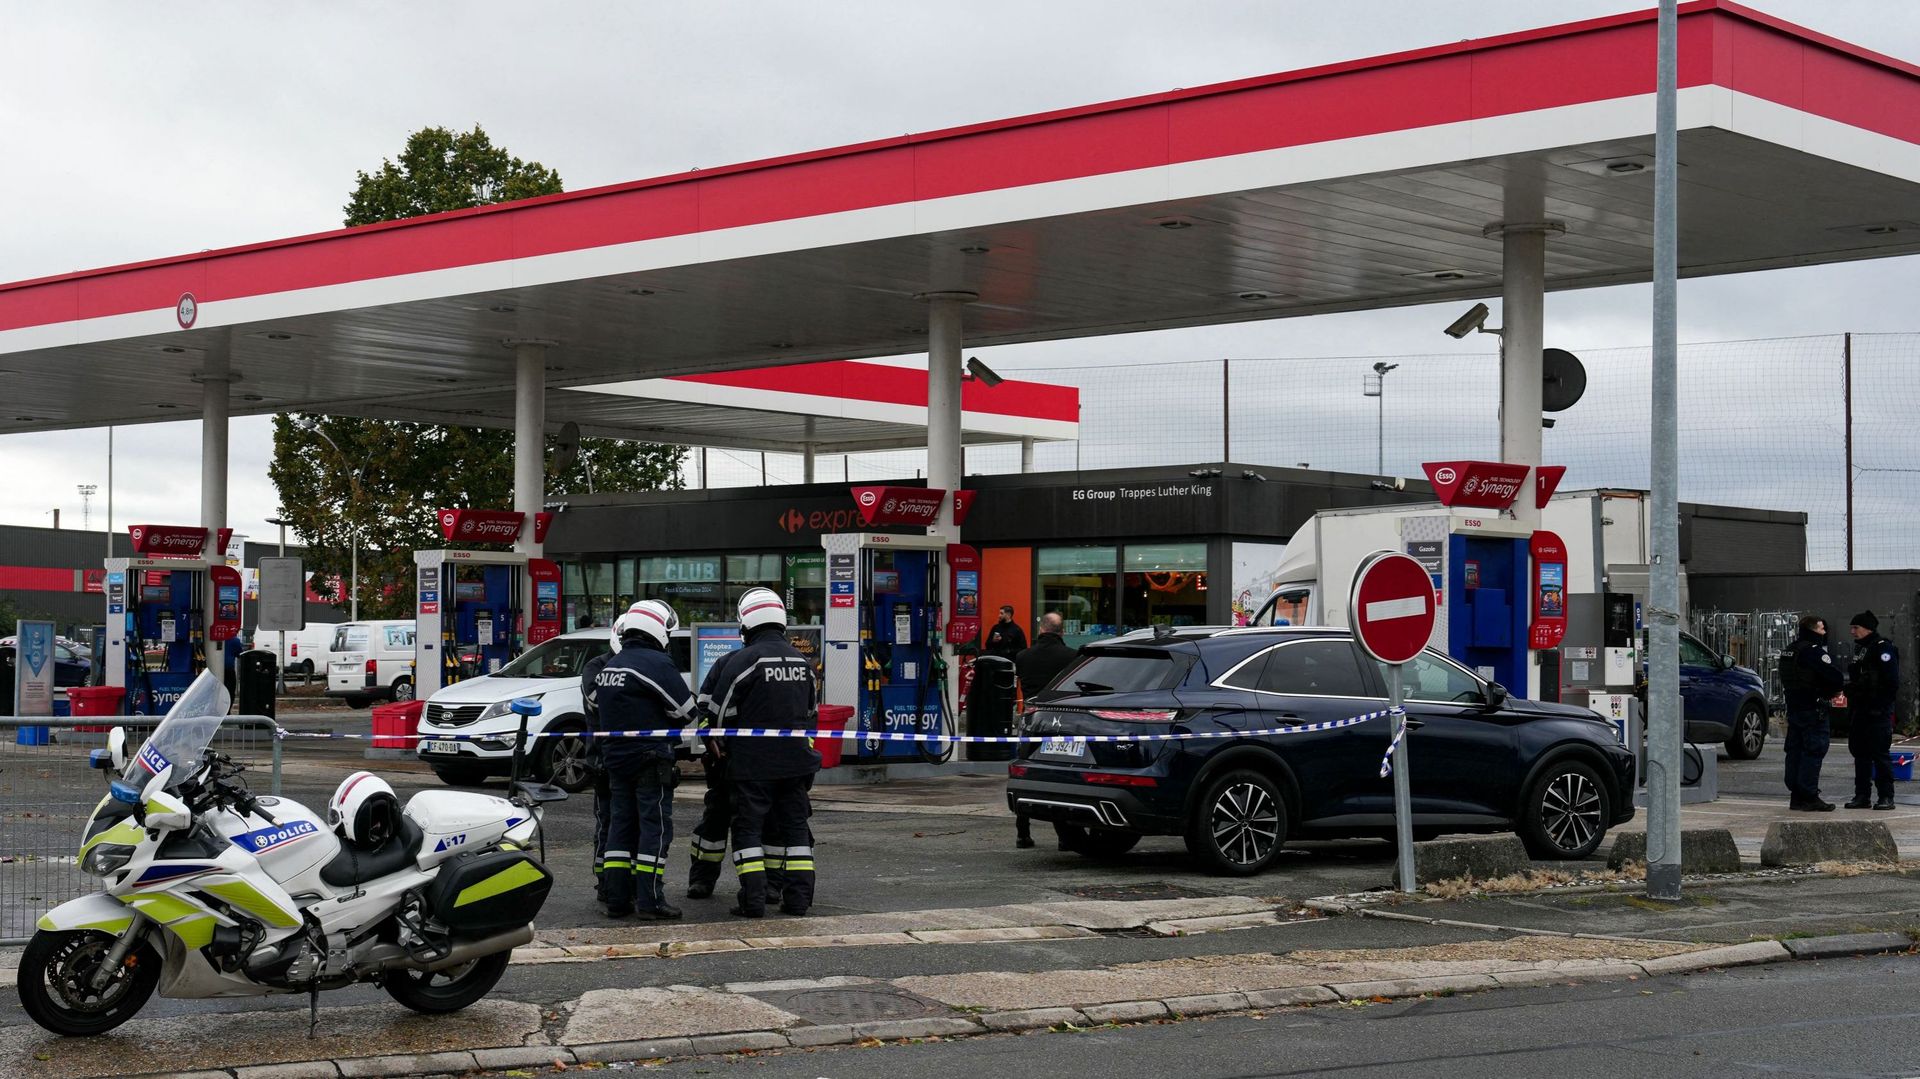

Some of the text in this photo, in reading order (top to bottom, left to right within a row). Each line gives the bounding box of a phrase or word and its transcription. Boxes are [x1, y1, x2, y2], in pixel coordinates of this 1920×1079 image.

[1438, 472, 1453, 480] Esso
[1539, 476, 1545, 489] 1
[1072, 484, 1212, 501] EG Group Trappes Luther King
[1478, 480, 1518, 498] Synergy
[897, 501, 936, 517] Synergy
[955, 498, 962, 510] 3
[477, 521, 518, 536] Synergy
[536, 520, 541, 530] 5
[808, 509, 884, 535] expre
[1464, 519, 1481, 528] ESSO
[163, 535, 201, 548] Synergy
[1418, 545, 1437, 553] Gazole
[665, 562, 715, 582] CLUB
[182, 613, 186, 621] 7
[500, 614, 505, 622] 5
[919, 608, 924, 617] 3
[703, 643, 732, 651] Adoptez
[764, 666, 807, 682] POLICE
[885, 709, 938, 731] Synegy
[268, 822, 313, 843] POLICE
[451, 834, 467, 846] 17
